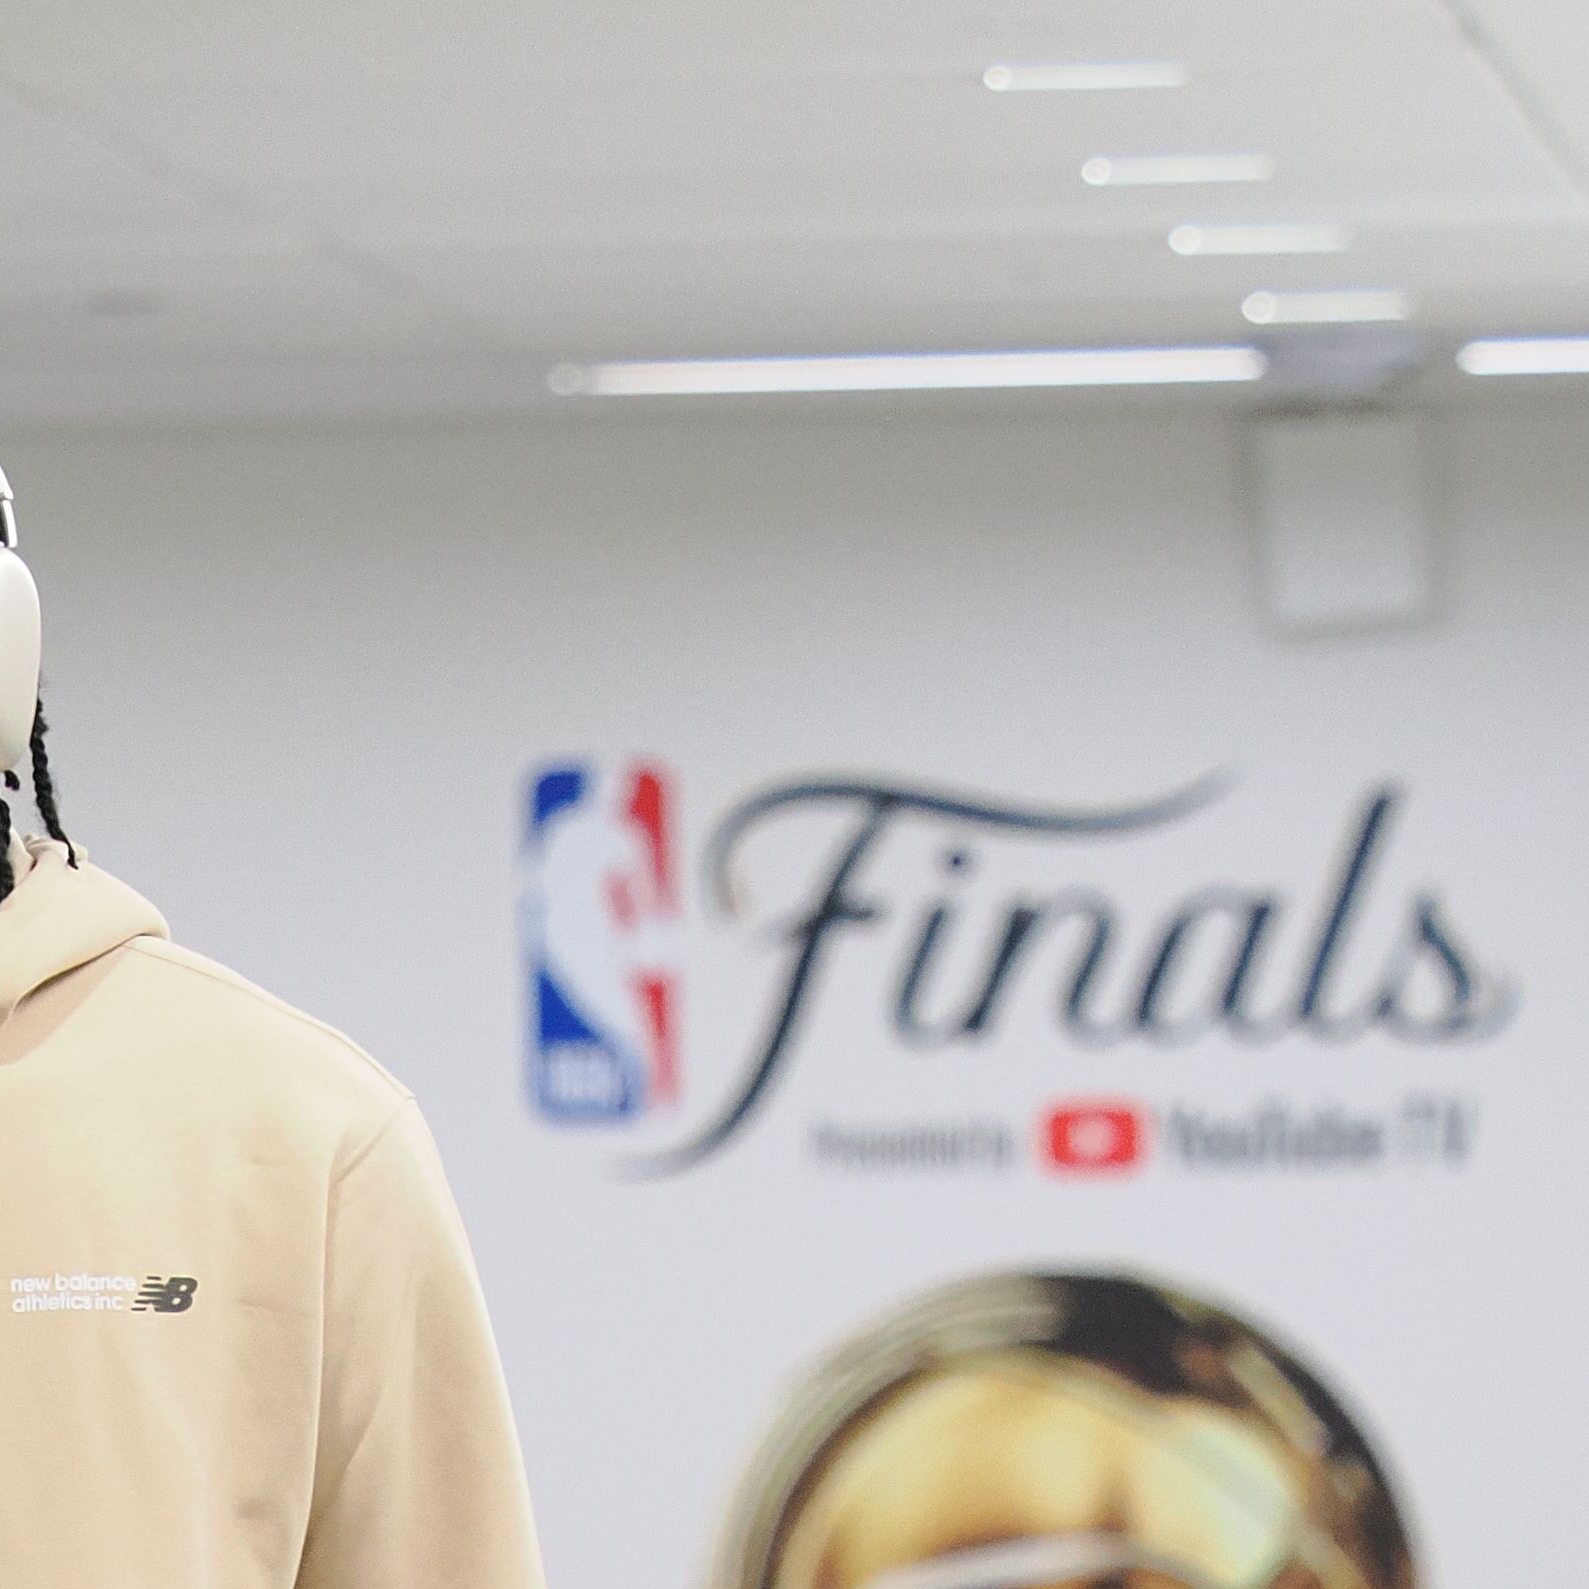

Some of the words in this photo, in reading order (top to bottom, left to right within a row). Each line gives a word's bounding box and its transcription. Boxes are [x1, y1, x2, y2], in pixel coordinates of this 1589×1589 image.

[616, 764, 1517, 1178] Finals
[11, 1278, 50, 1293] new
[54, 1273, 136, 1292] balance
[12, 1293, 92, 1313] athletics
